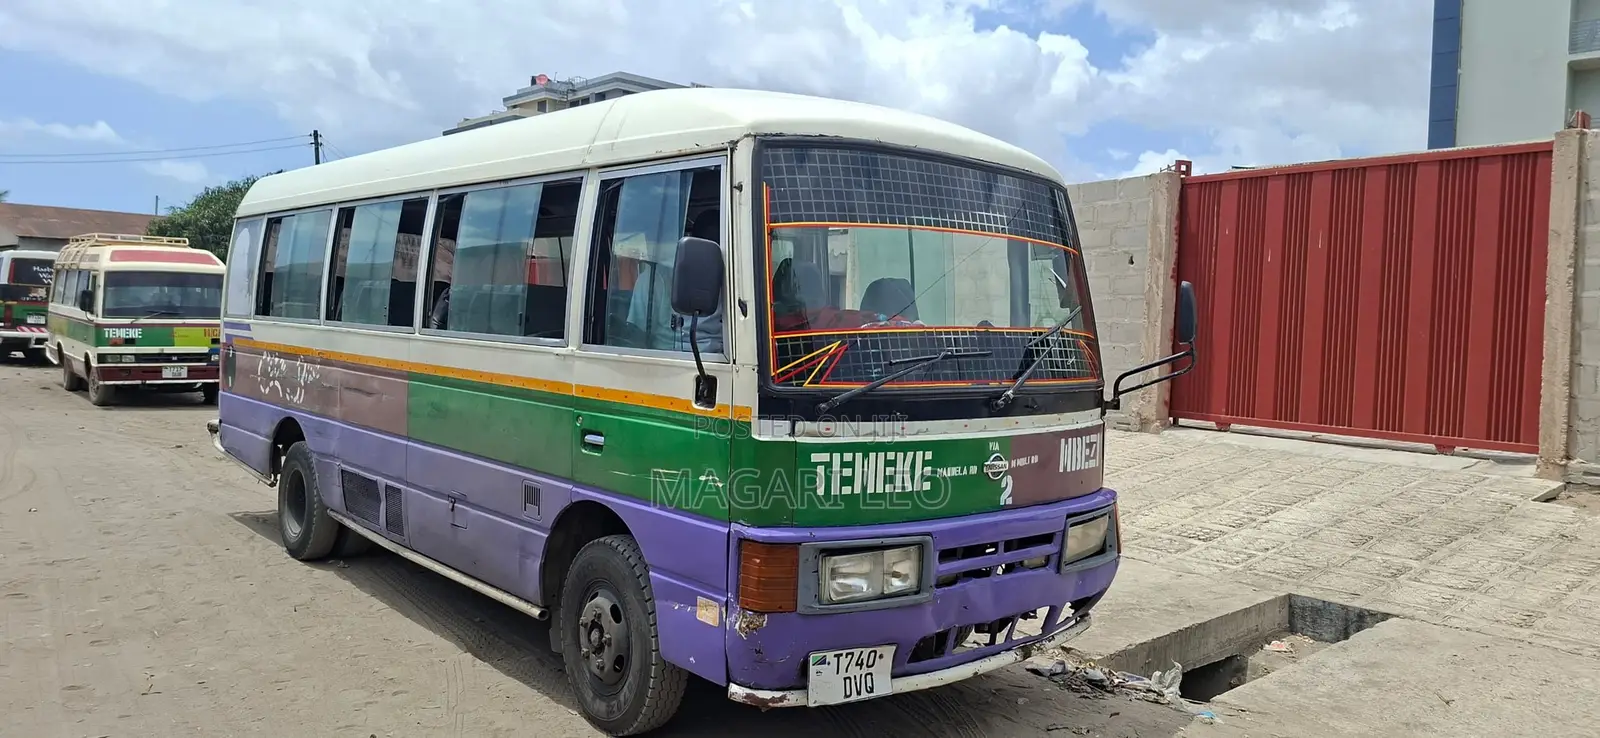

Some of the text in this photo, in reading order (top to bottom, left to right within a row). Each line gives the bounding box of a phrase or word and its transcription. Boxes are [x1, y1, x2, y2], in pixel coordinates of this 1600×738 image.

[103, 328, 142, 338] TEMEKE
[989, 442, 1000, 451] VIA
[1059, 432, 1100, 473] MBEZI
[810, 451, 932, 495] TEMEKE
[985, 463, 1008, 472] NISSAN
[1000, 475, 1013, 505] 2
[833, 650, 877, 675] T740
[843, 672, 874, 699] DVQ
